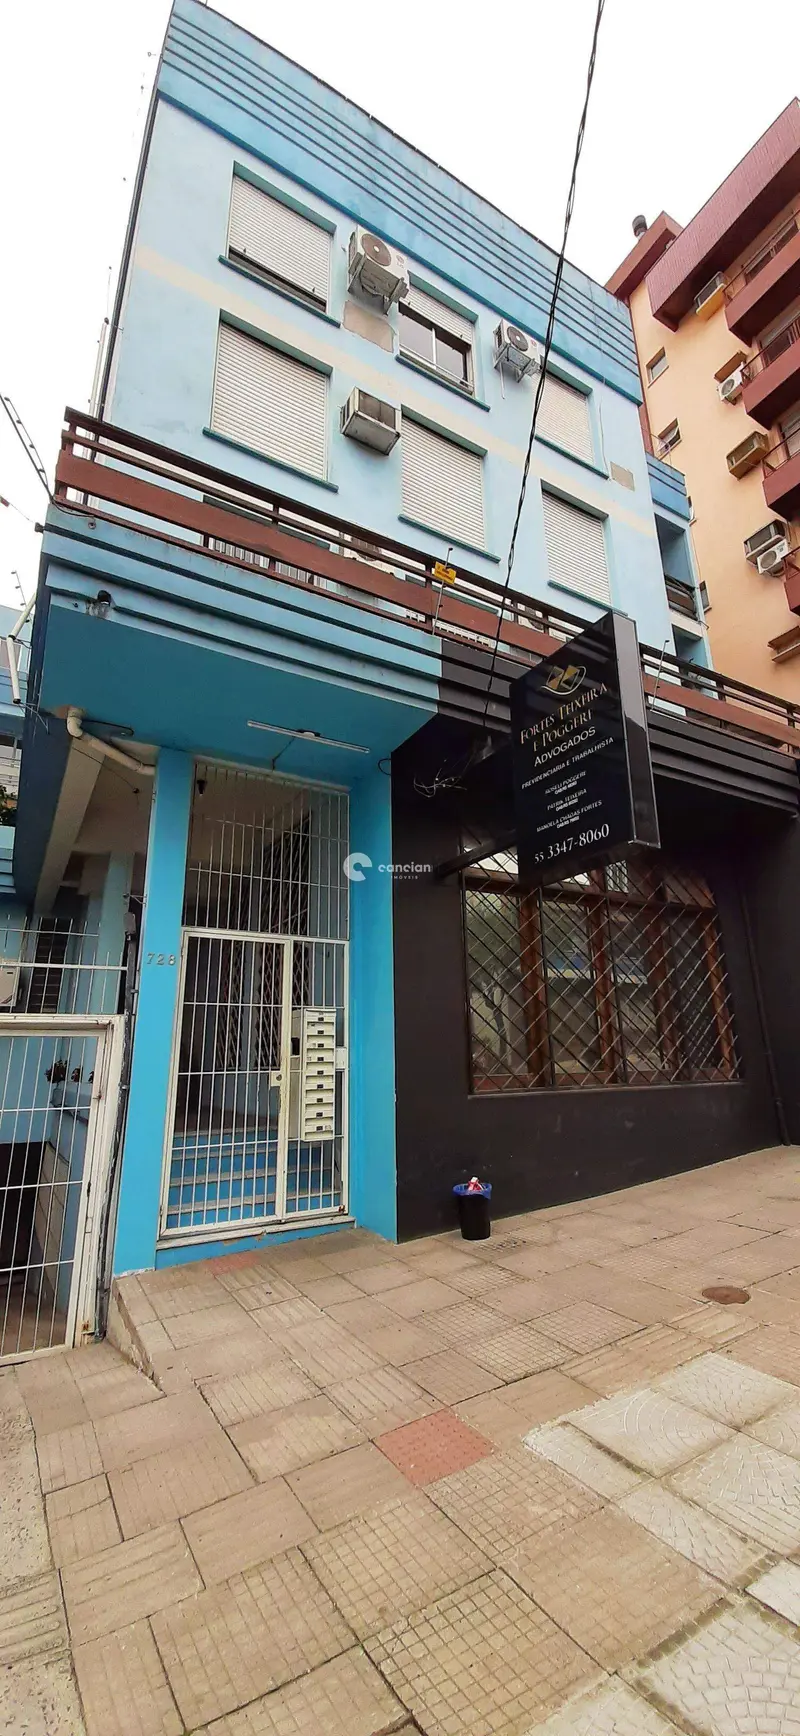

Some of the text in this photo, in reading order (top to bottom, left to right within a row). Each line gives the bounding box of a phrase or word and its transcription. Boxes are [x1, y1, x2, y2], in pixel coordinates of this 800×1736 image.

[520, 682, 608, 744] FORTES TEIXEIRA
[534, 726, 596, 767] ADVOGADOS
[572, 737, 614, 763] TRABALHISTA
[534, 823, 610, 864] 55 3347-8060
[146, 952, 176, 966] 728
